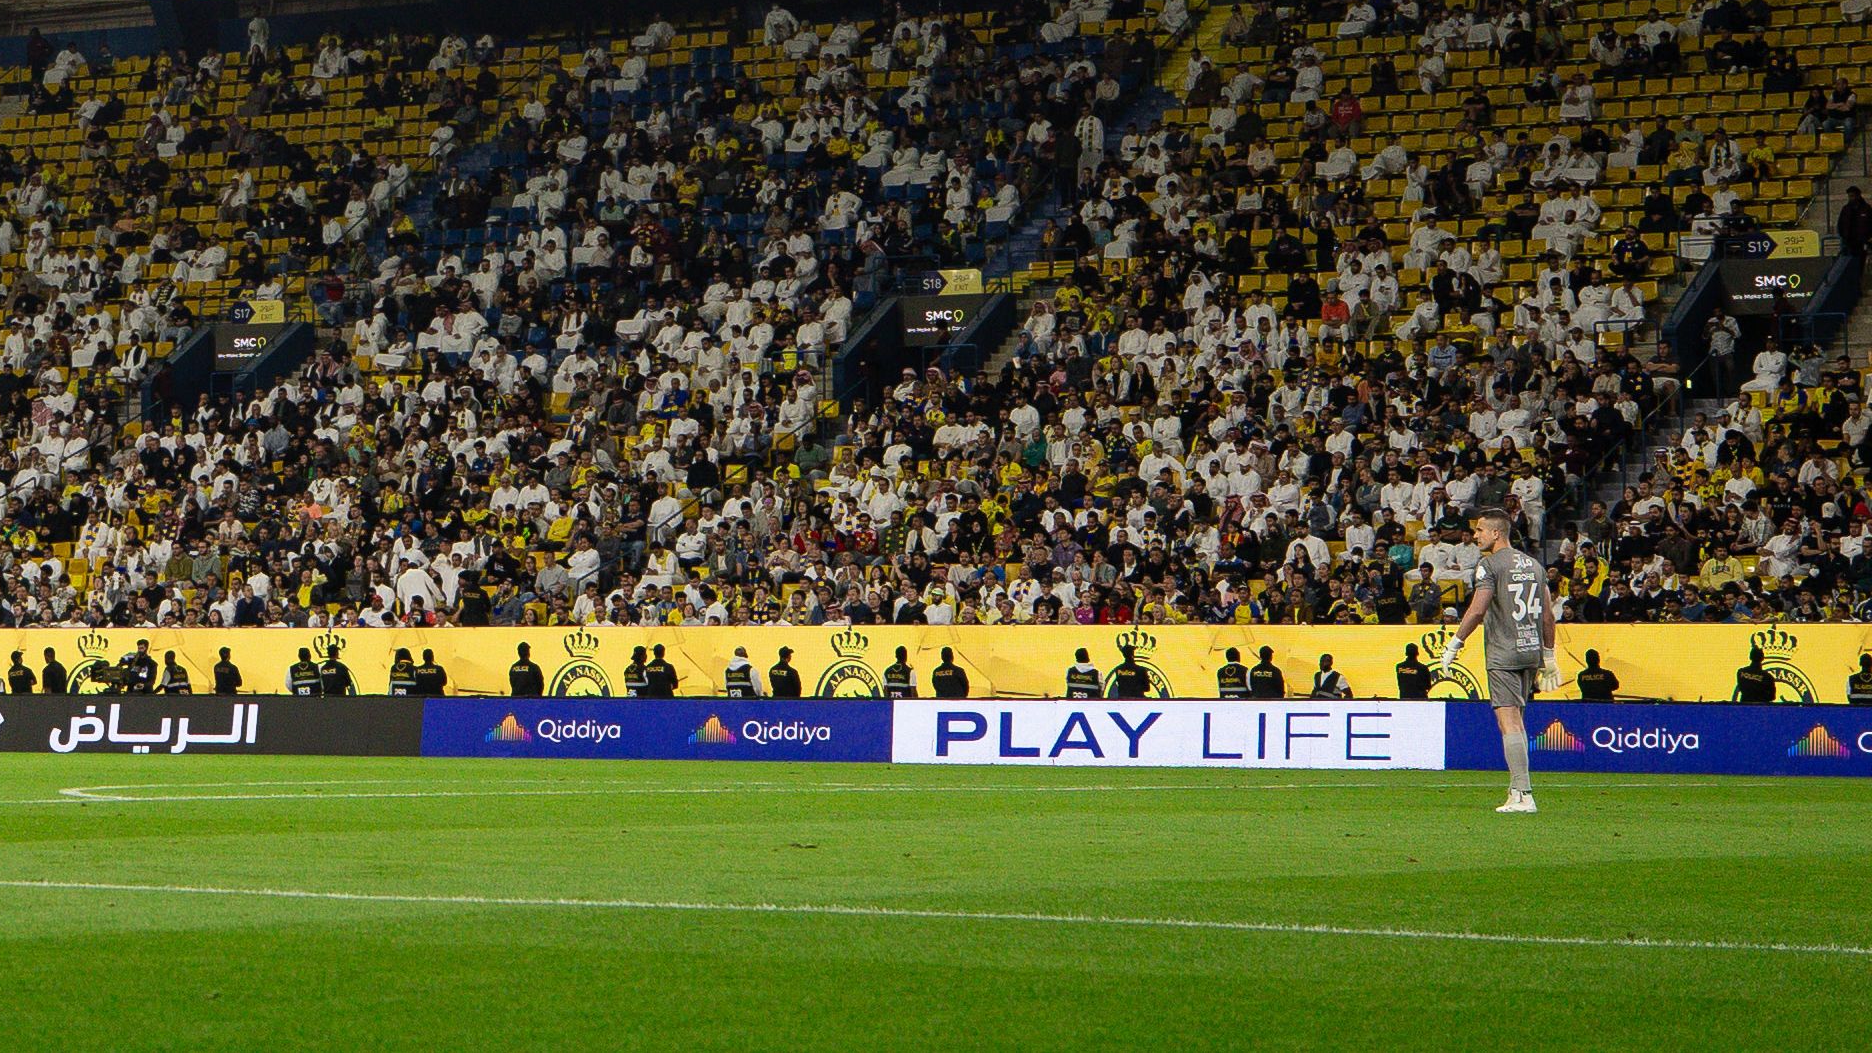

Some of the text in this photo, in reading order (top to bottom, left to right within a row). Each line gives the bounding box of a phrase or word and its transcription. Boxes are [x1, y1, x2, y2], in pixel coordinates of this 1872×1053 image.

[1747, 240, 1771, 253] S19
[923, 278, 942, 290] S18
[1754, 275, 1787, 287] SMC
[234, 308, 251, 319] S17
[925, 310, 953, 322] SMC
[233, 337, 257, 348] SMC
[1508, 582, 1542, 622] 34
[417, 667, 437, 675] POLICE
[562, 665, 606, 689] AL NASSR
[1253, 669, 1273, 678] POLICE
[1739, 671, 1764, 682] POLICE
[829, 674, 843, 690] AL
[844, 666, 876, 689] NASSR
[1581, 673, 1605, 682] POLICE
[48, 703, 259, 754] الرياض
[537, 719, 622, 743] Qiddiya
[742, 720, 831, 745] Qiddiya
[934, 711, 1393, 761] PLAY LIFE
[1591, 726, 1700, 754] Qiddiya
